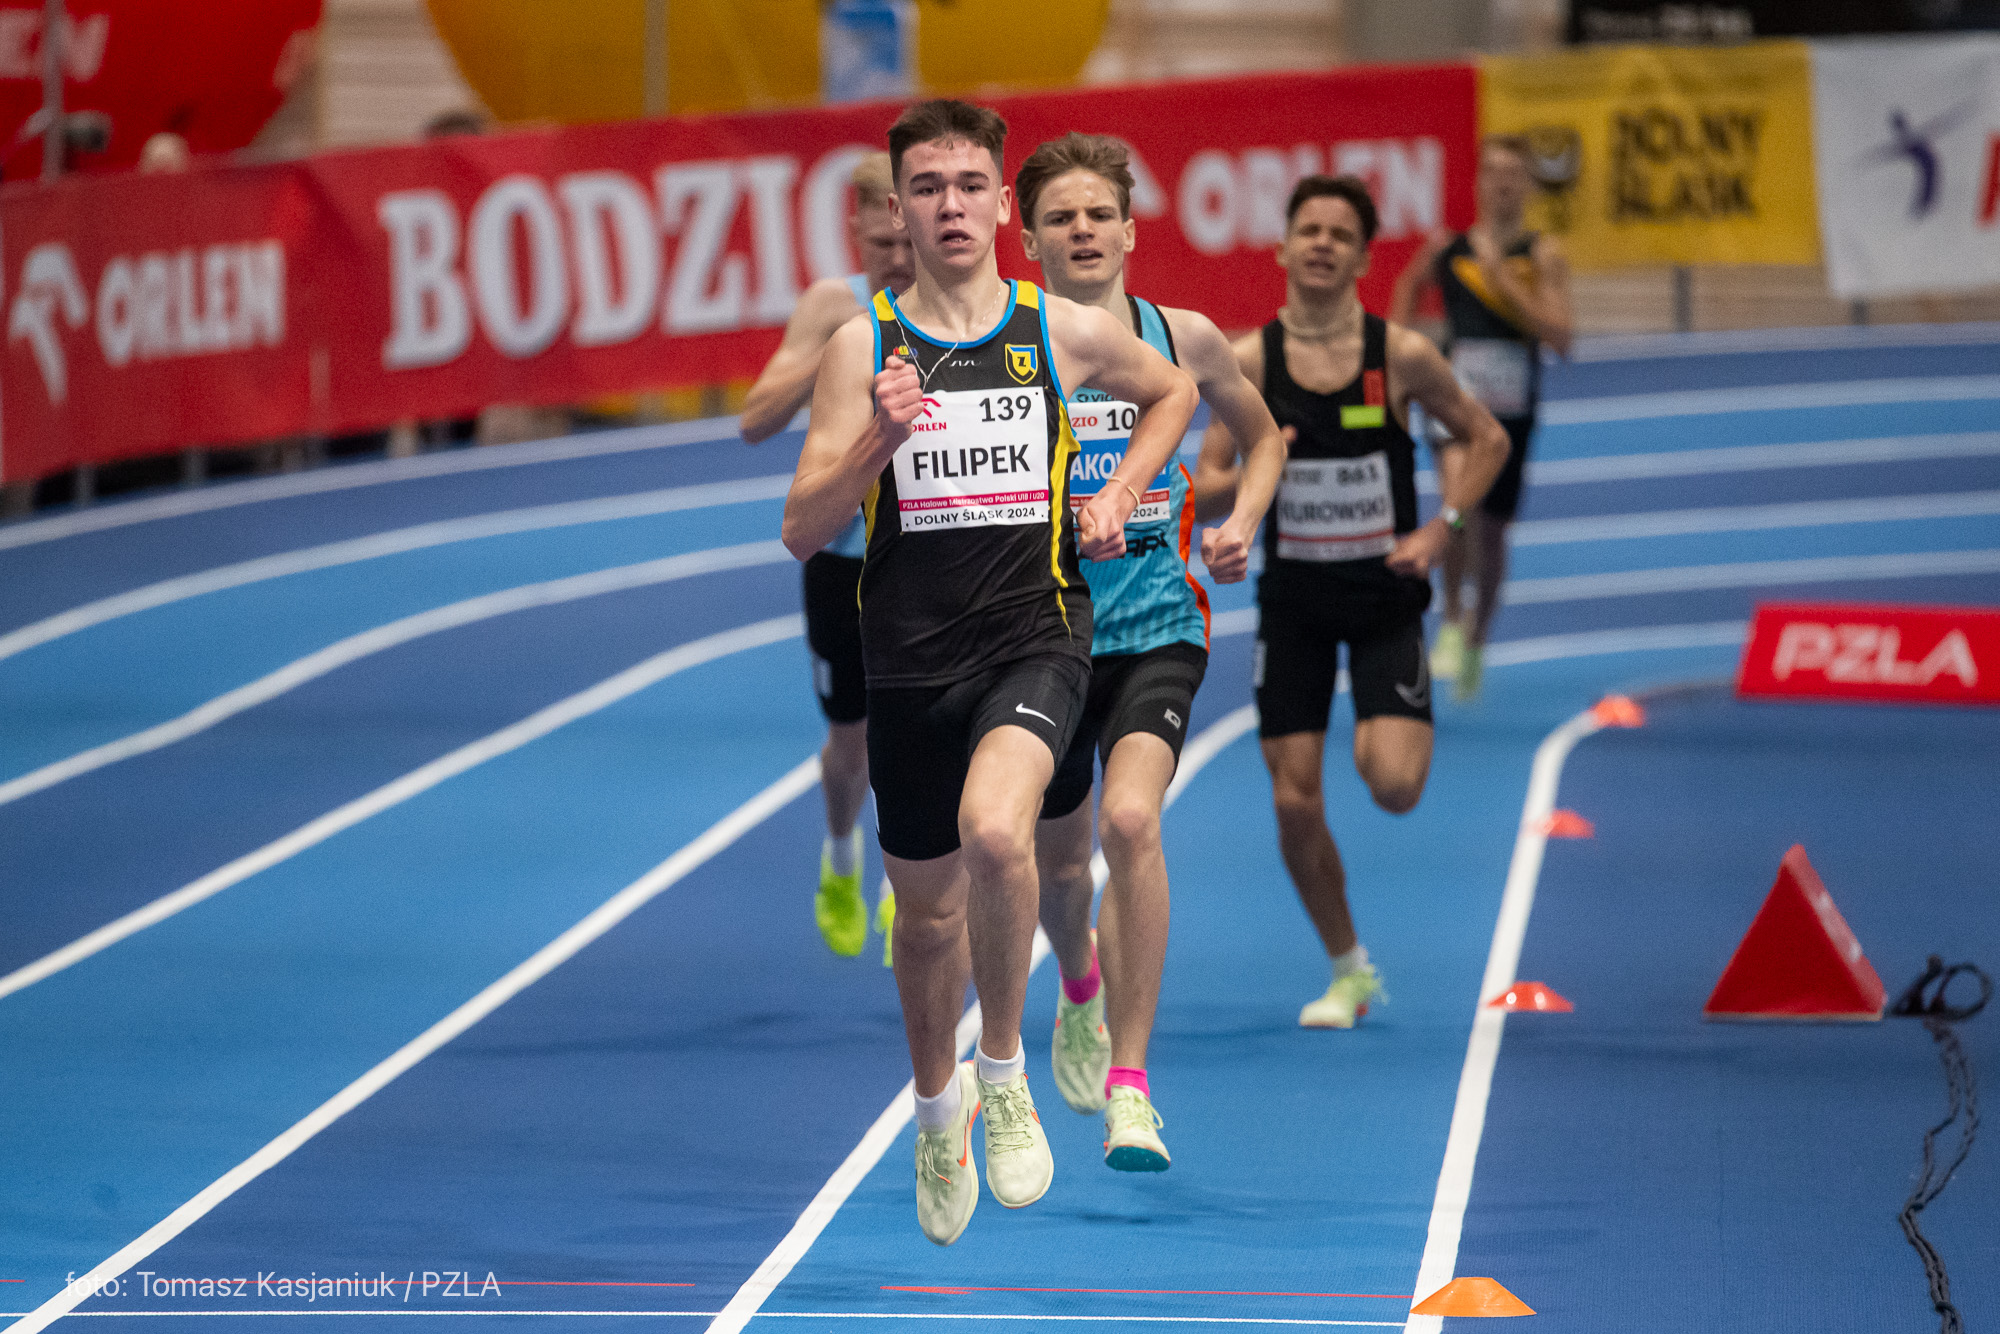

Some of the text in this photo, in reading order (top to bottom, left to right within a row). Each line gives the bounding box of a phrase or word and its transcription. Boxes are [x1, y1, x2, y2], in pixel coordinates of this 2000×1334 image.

[979, 395, 1032, 422] 139
[1071, 416, 1098, 428] ZIO
[912, 443, 1031, 481] FILIPEK
[902, 501, 919, 510] PZLA
[920, 499, 948, 509] Halowe
[995, 493, 1017, 504] Polski
[1033, 491, 1045, 501] U20
[914, 507, 1036, 526] DOLNY ŚLĄSK 2024
[1133, 507, 1158, 518] 2024
[1773, 622, 1978, 688] PZLA
